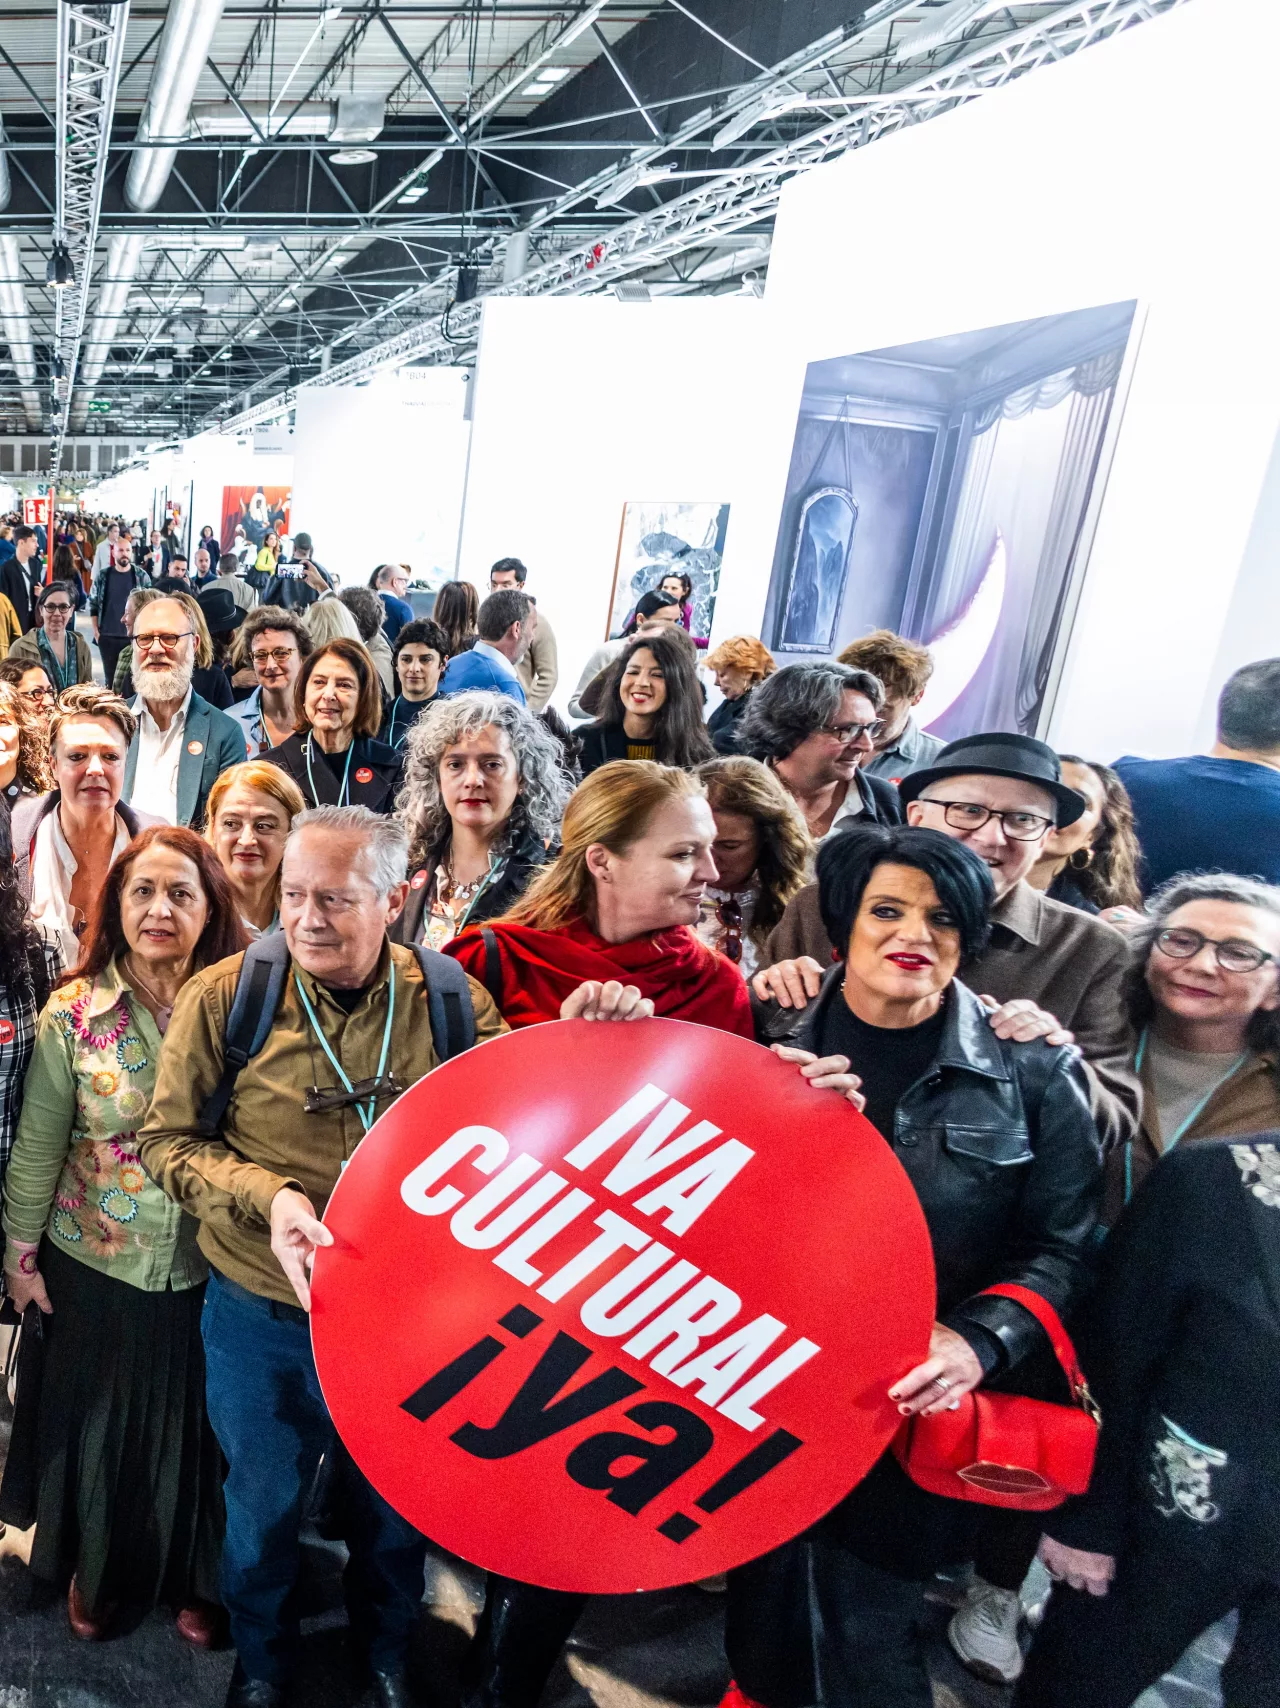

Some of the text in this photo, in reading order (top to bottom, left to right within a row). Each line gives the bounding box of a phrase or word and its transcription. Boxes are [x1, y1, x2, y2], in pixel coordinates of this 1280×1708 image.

[400, 1125, 822, 1433] CULTURAL
[563, 1083, 756, 1238] IVA
[400, 1304, 804, 1545] ¡ya!
